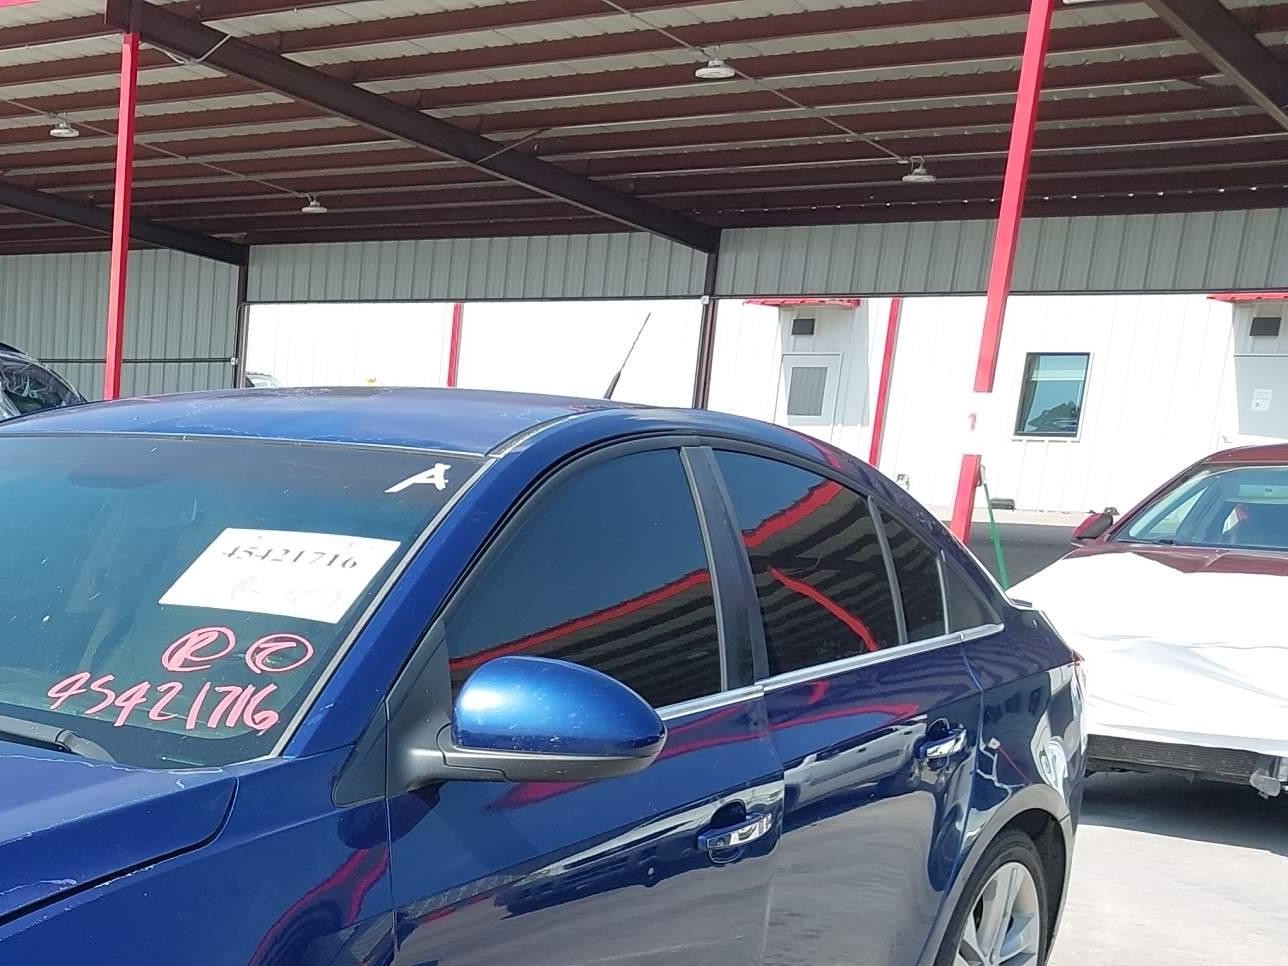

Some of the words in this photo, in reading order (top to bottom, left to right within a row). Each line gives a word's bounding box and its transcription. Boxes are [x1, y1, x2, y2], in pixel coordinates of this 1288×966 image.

[384, 462, 452, 493] A
[221, 545, 358, 569] 45421716
[47, 671, 281, 736] 45421716
